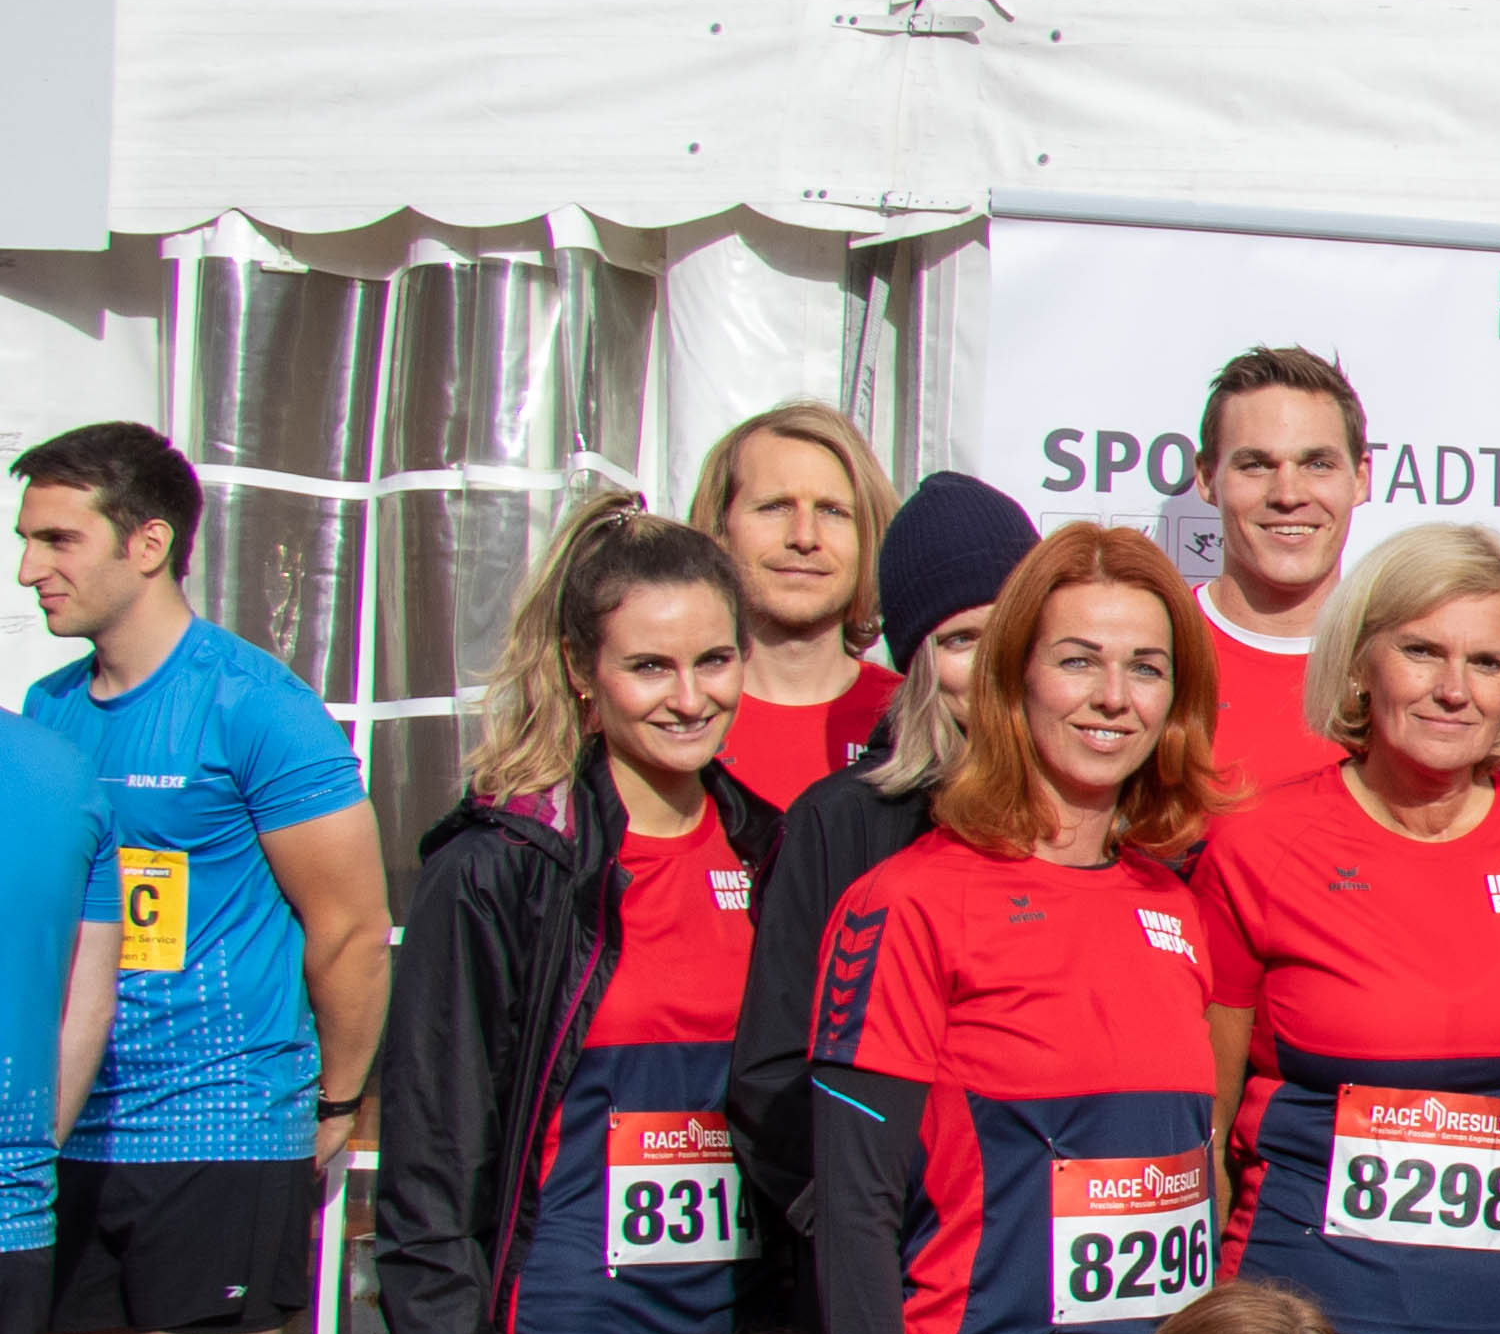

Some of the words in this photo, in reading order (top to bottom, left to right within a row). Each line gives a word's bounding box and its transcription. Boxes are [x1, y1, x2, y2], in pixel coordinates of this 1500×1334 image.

[126, 774, 188, 789] RUN.EXE
[1371, 1105, 1423, 1127] RACE
[643, 1130, 688, 1149] RACE
[1089, 1178, 1143, 1199] RACE
[1164, 1168, 1201, 1195] RESULT
[1069, 1218, 1208, 1303] 8296
